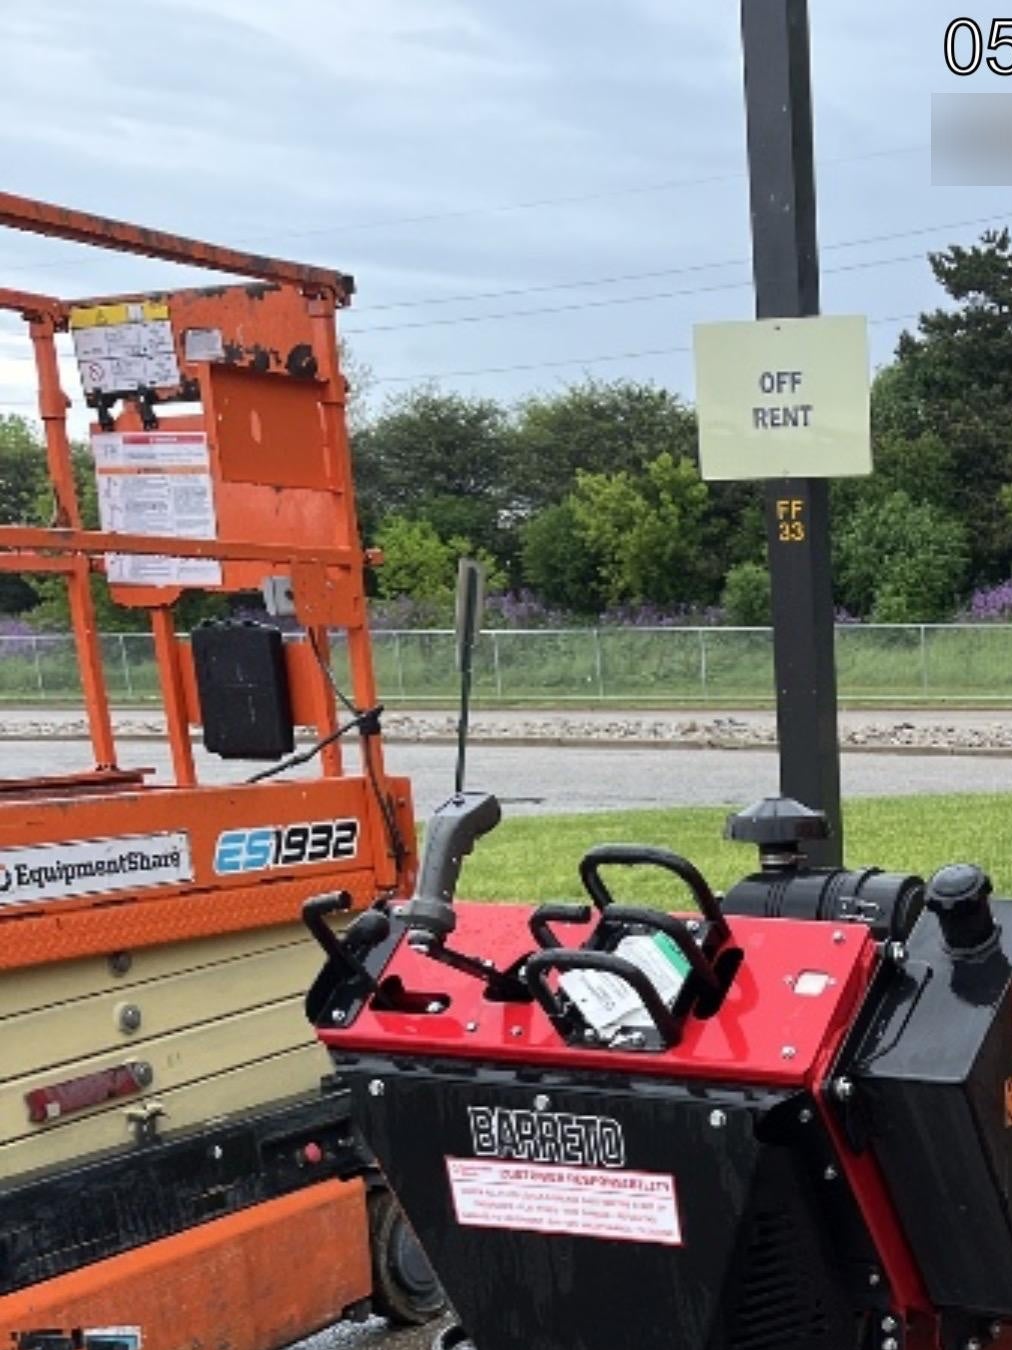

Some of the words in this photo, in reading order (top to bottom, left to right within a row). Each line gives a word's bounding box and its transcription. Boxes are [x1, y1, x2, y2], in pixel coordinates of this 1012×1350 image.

[759, 371, 803, 394] OFF
[753, 404, 813, 429] RENT
[775, 500, 804, 520] FF
[215, 820, 358, 874] ES1932
[14, 850, 181, 888] EquipmentShare
[468, 1106, 626, 1167] BARRETO
